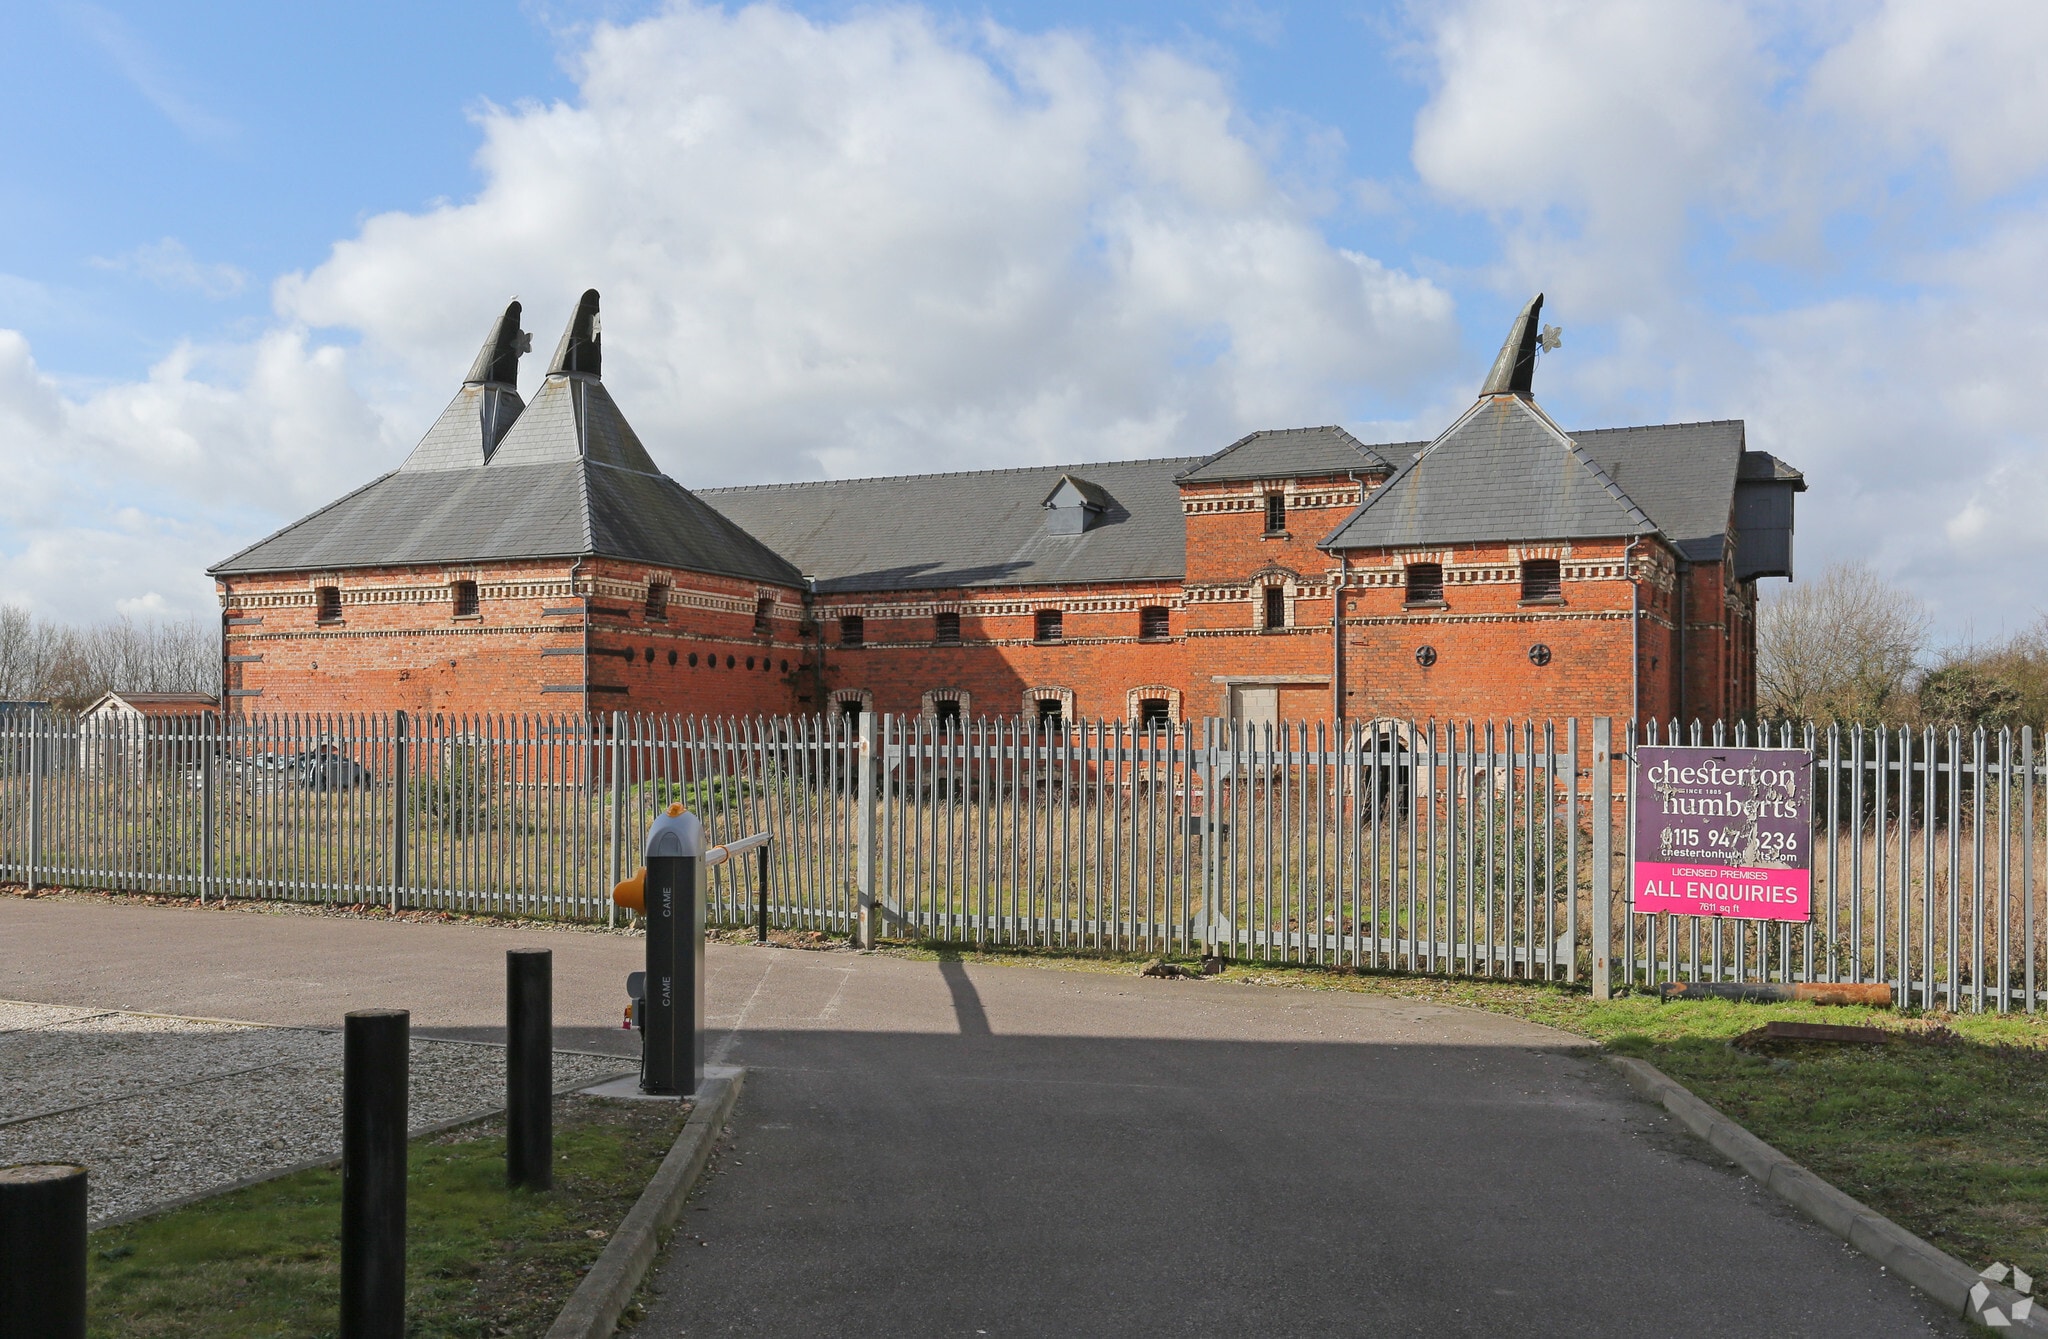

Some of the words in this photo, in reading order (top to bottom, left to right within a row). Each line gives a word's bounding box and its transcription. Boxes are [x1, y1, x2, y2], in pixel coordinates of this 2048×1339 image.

[1647, 759, 1796, 787] chesterton
[1678, 787, 1703, 795] INCE
[1661, 791, 1798, 819] humberts
[1708, 827, 1740, 848] 947
[1671, 867, 1718, 878] LICENSED
[1720, 869, 1768, 881] PREMISES
[662, 887, 672, 918] CAME
[1643, 879, 1682, 898] ALL
[1686, 881, 1798, 904] ENQUIRIES
[1699, 902, 1716, 912] 7611
[1719, 904, 1731, 913] sq
[1733, 904, 1740, 913] ft
[662, 976, 671, 1007] CAME
